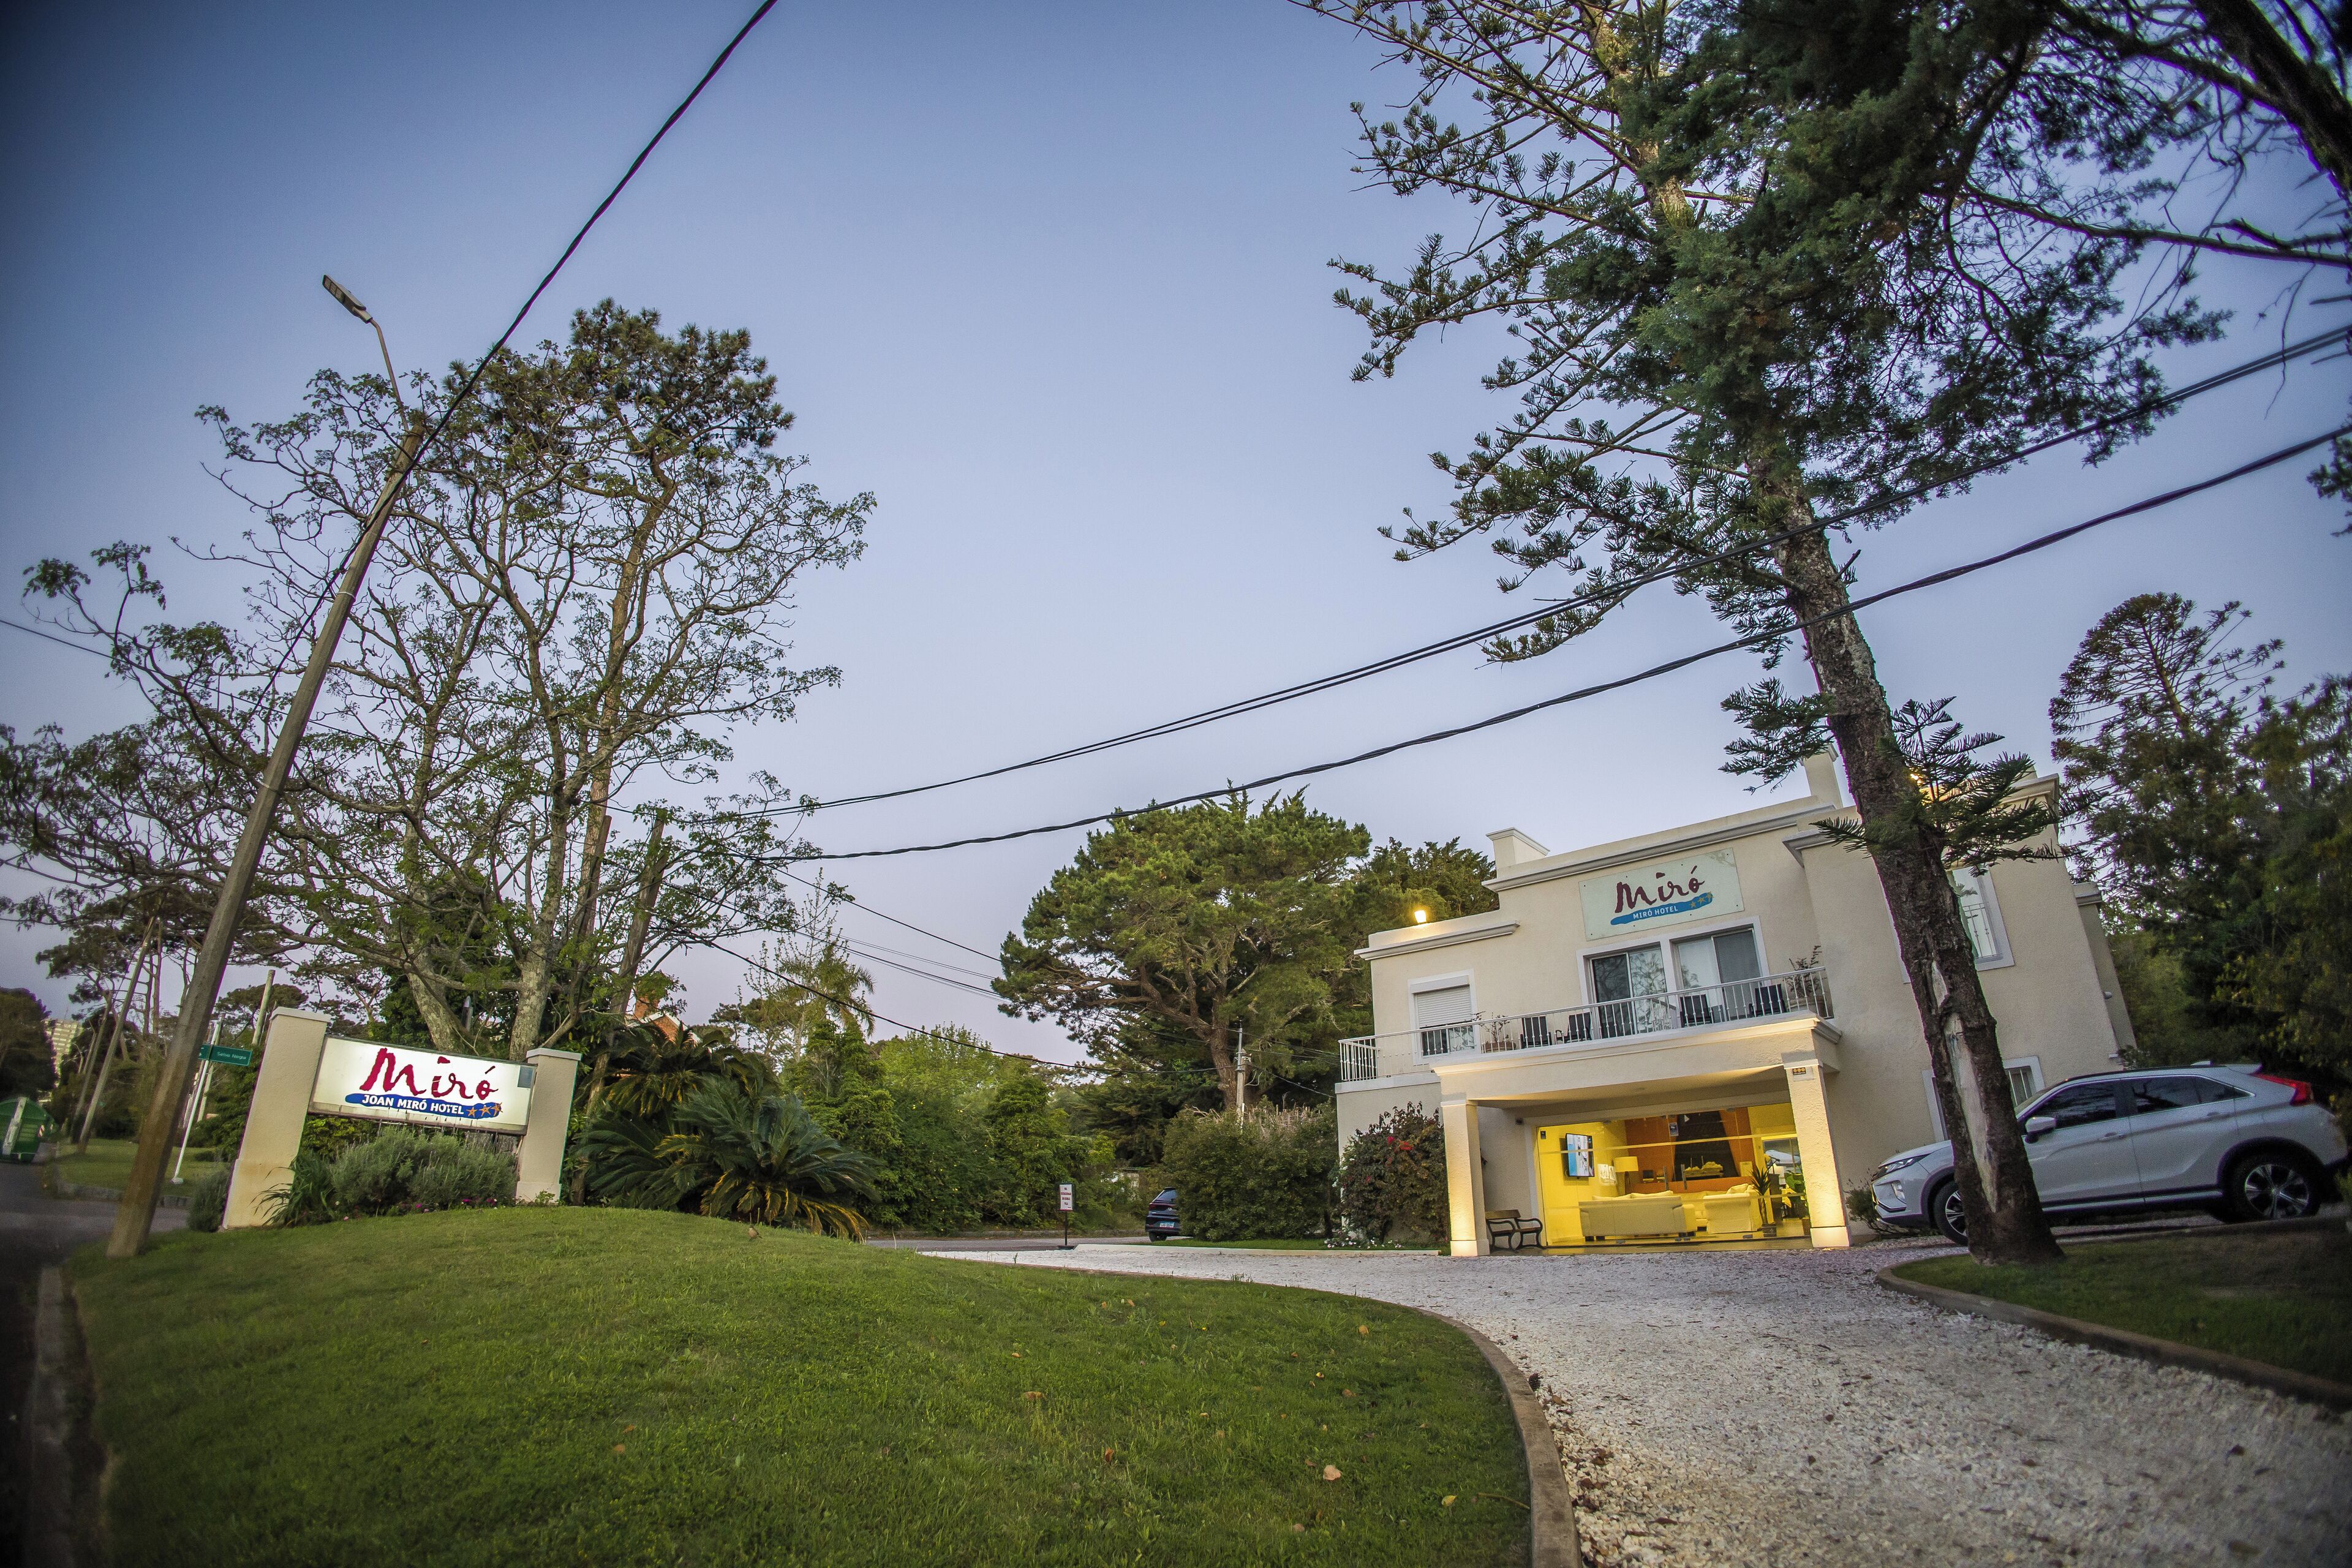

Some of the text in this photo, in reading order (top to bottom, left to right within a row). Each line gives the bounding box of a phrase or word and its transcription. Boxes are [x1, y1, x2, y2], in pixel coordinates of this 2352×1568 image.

[1615, 865, 1705, 913] Miró
[1633, 905, 1678, 919] MIRÓ HOTEL
[360, 1048, 499, 1100] Miró
[362, 1094, 464, 1115] JOAN MIRÓ HOTEL
